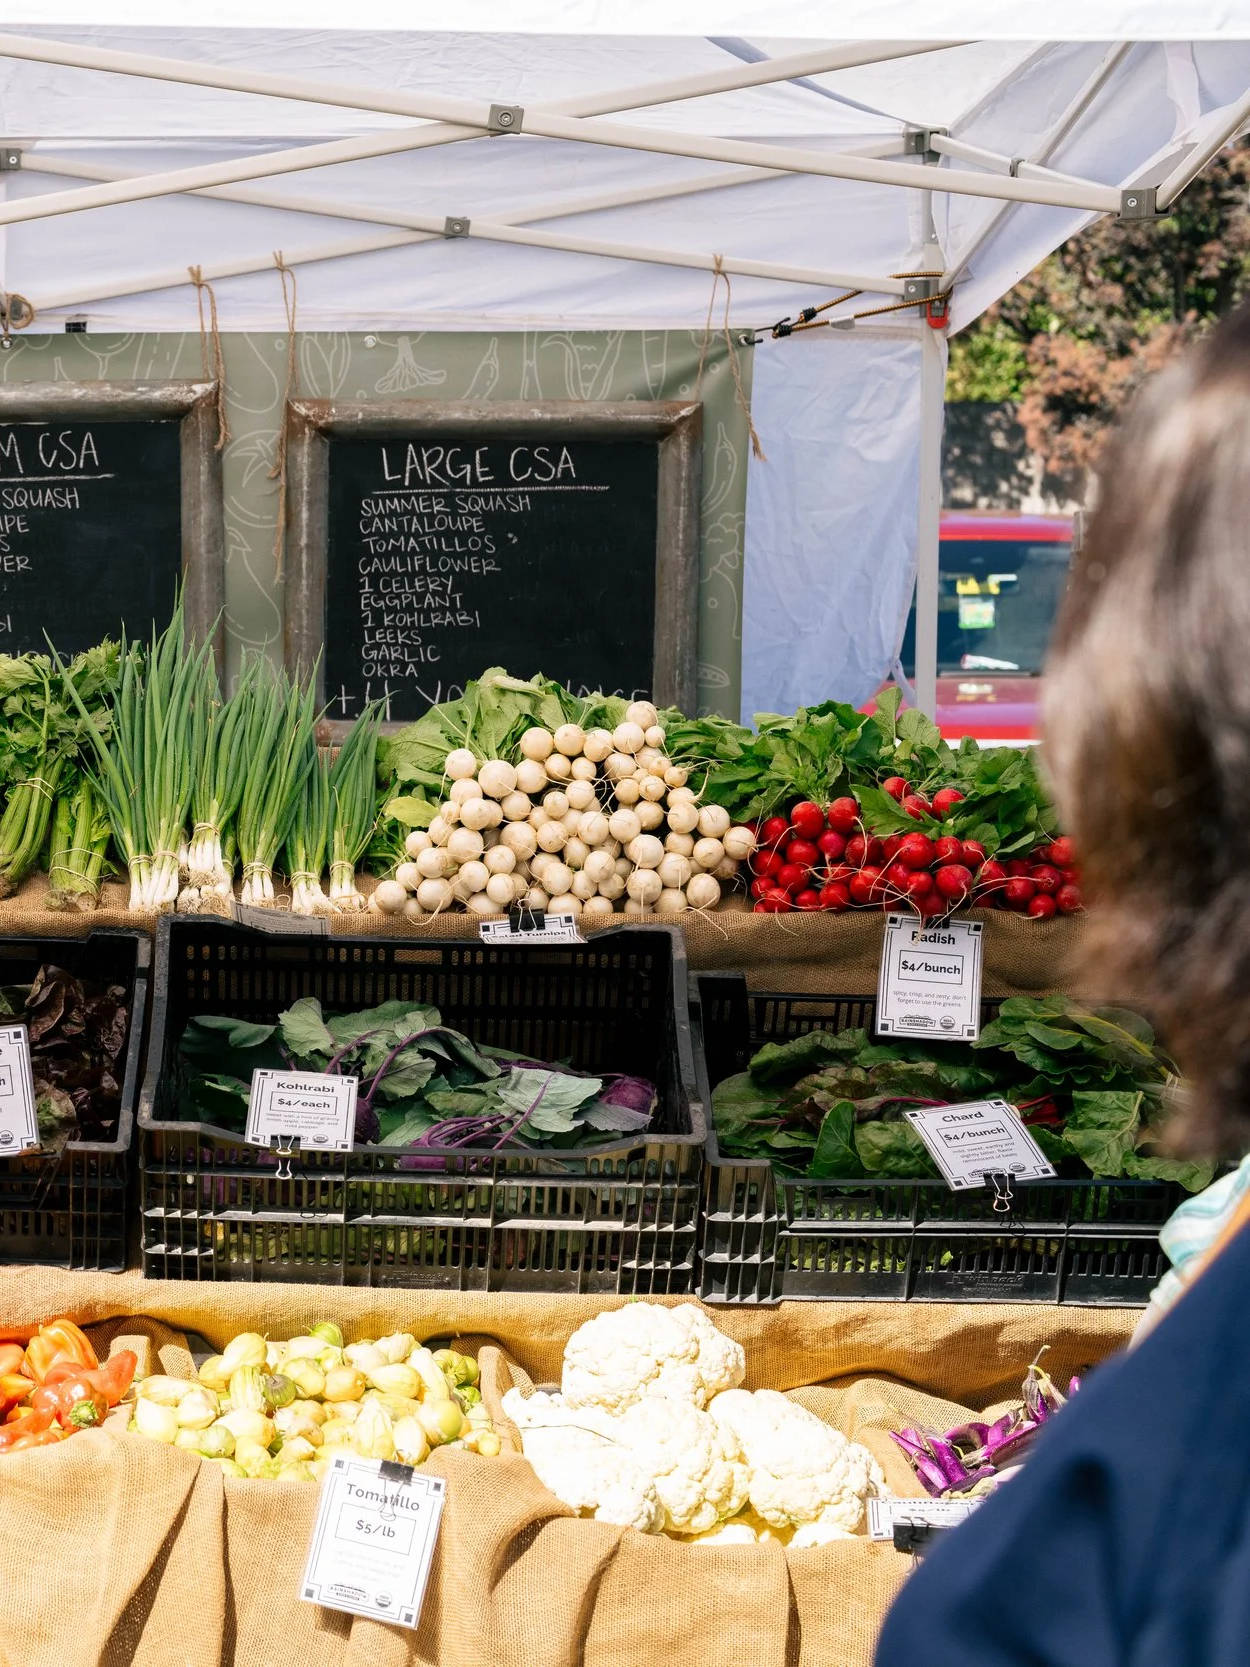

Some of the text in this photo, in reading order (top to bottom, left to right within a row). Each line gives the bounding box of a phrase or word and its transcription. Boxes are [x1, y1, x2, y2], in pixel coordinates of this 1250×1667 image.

[38, 430, 99, 470] CSA
[382, 444, 576, 486] LARGE CSA
[1, 487, 80, 509] SQUASH
[361, 493, 532, 517] SUMMER SQUASH
[359, 515, 486, 535] CANTALOUPE
[358, 555, 502, 577] CAULIFLOWER
[359, 575, 454, 595] 1 CELERY
[360, 592, 464, 612] EGGPLANT
[361, 610, 481, 628] 1 KOHLRABI
[364, 628, 423, 646] LEEKS
[361, 644, 441, 664] GARLIC
[362, 662, 419, 679] OKRA
[901, 959, 961, 975] $4/bunch
[276, 1081, 335, 1094] Kohlrabi
[277, 1097, 331, 1109] $4/each
[941, 1111, 985, 1123] Chard
[943, 1127, 1006, 1141] $4/bunch
[346, 1482, 420, 1511] Tomatillo
[355, 1518, 396, 1539] $5/lb
